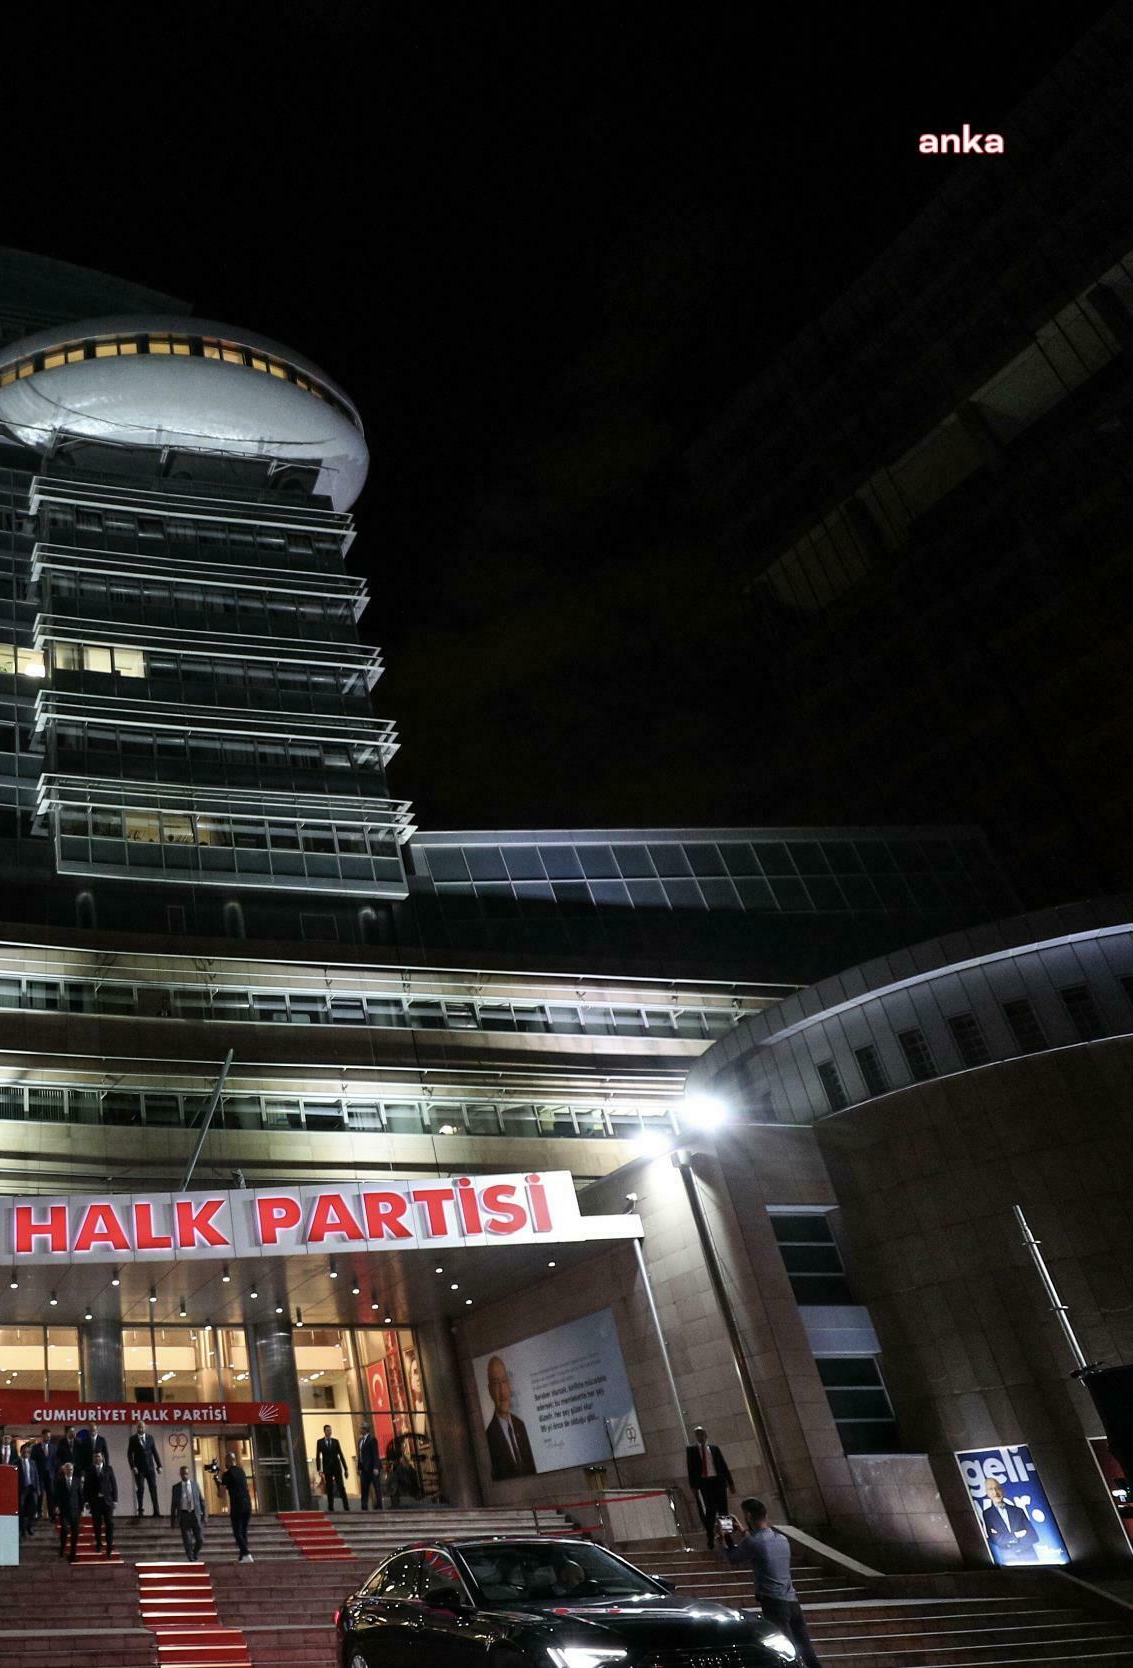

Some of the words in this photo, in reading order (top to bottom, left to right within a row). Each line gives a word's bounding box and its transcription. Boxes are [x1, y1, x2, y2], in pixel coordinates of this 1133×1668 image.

[13, 1200, 232, 1254] HALK
[255, 1174, 554, 1246] PARTİSİ
[33, 1406, 127, 1421] CUMHURİYET
[131, 1409, 169, 1421] HALK
[173, 1406, 227, 1421] PARTİSİ
